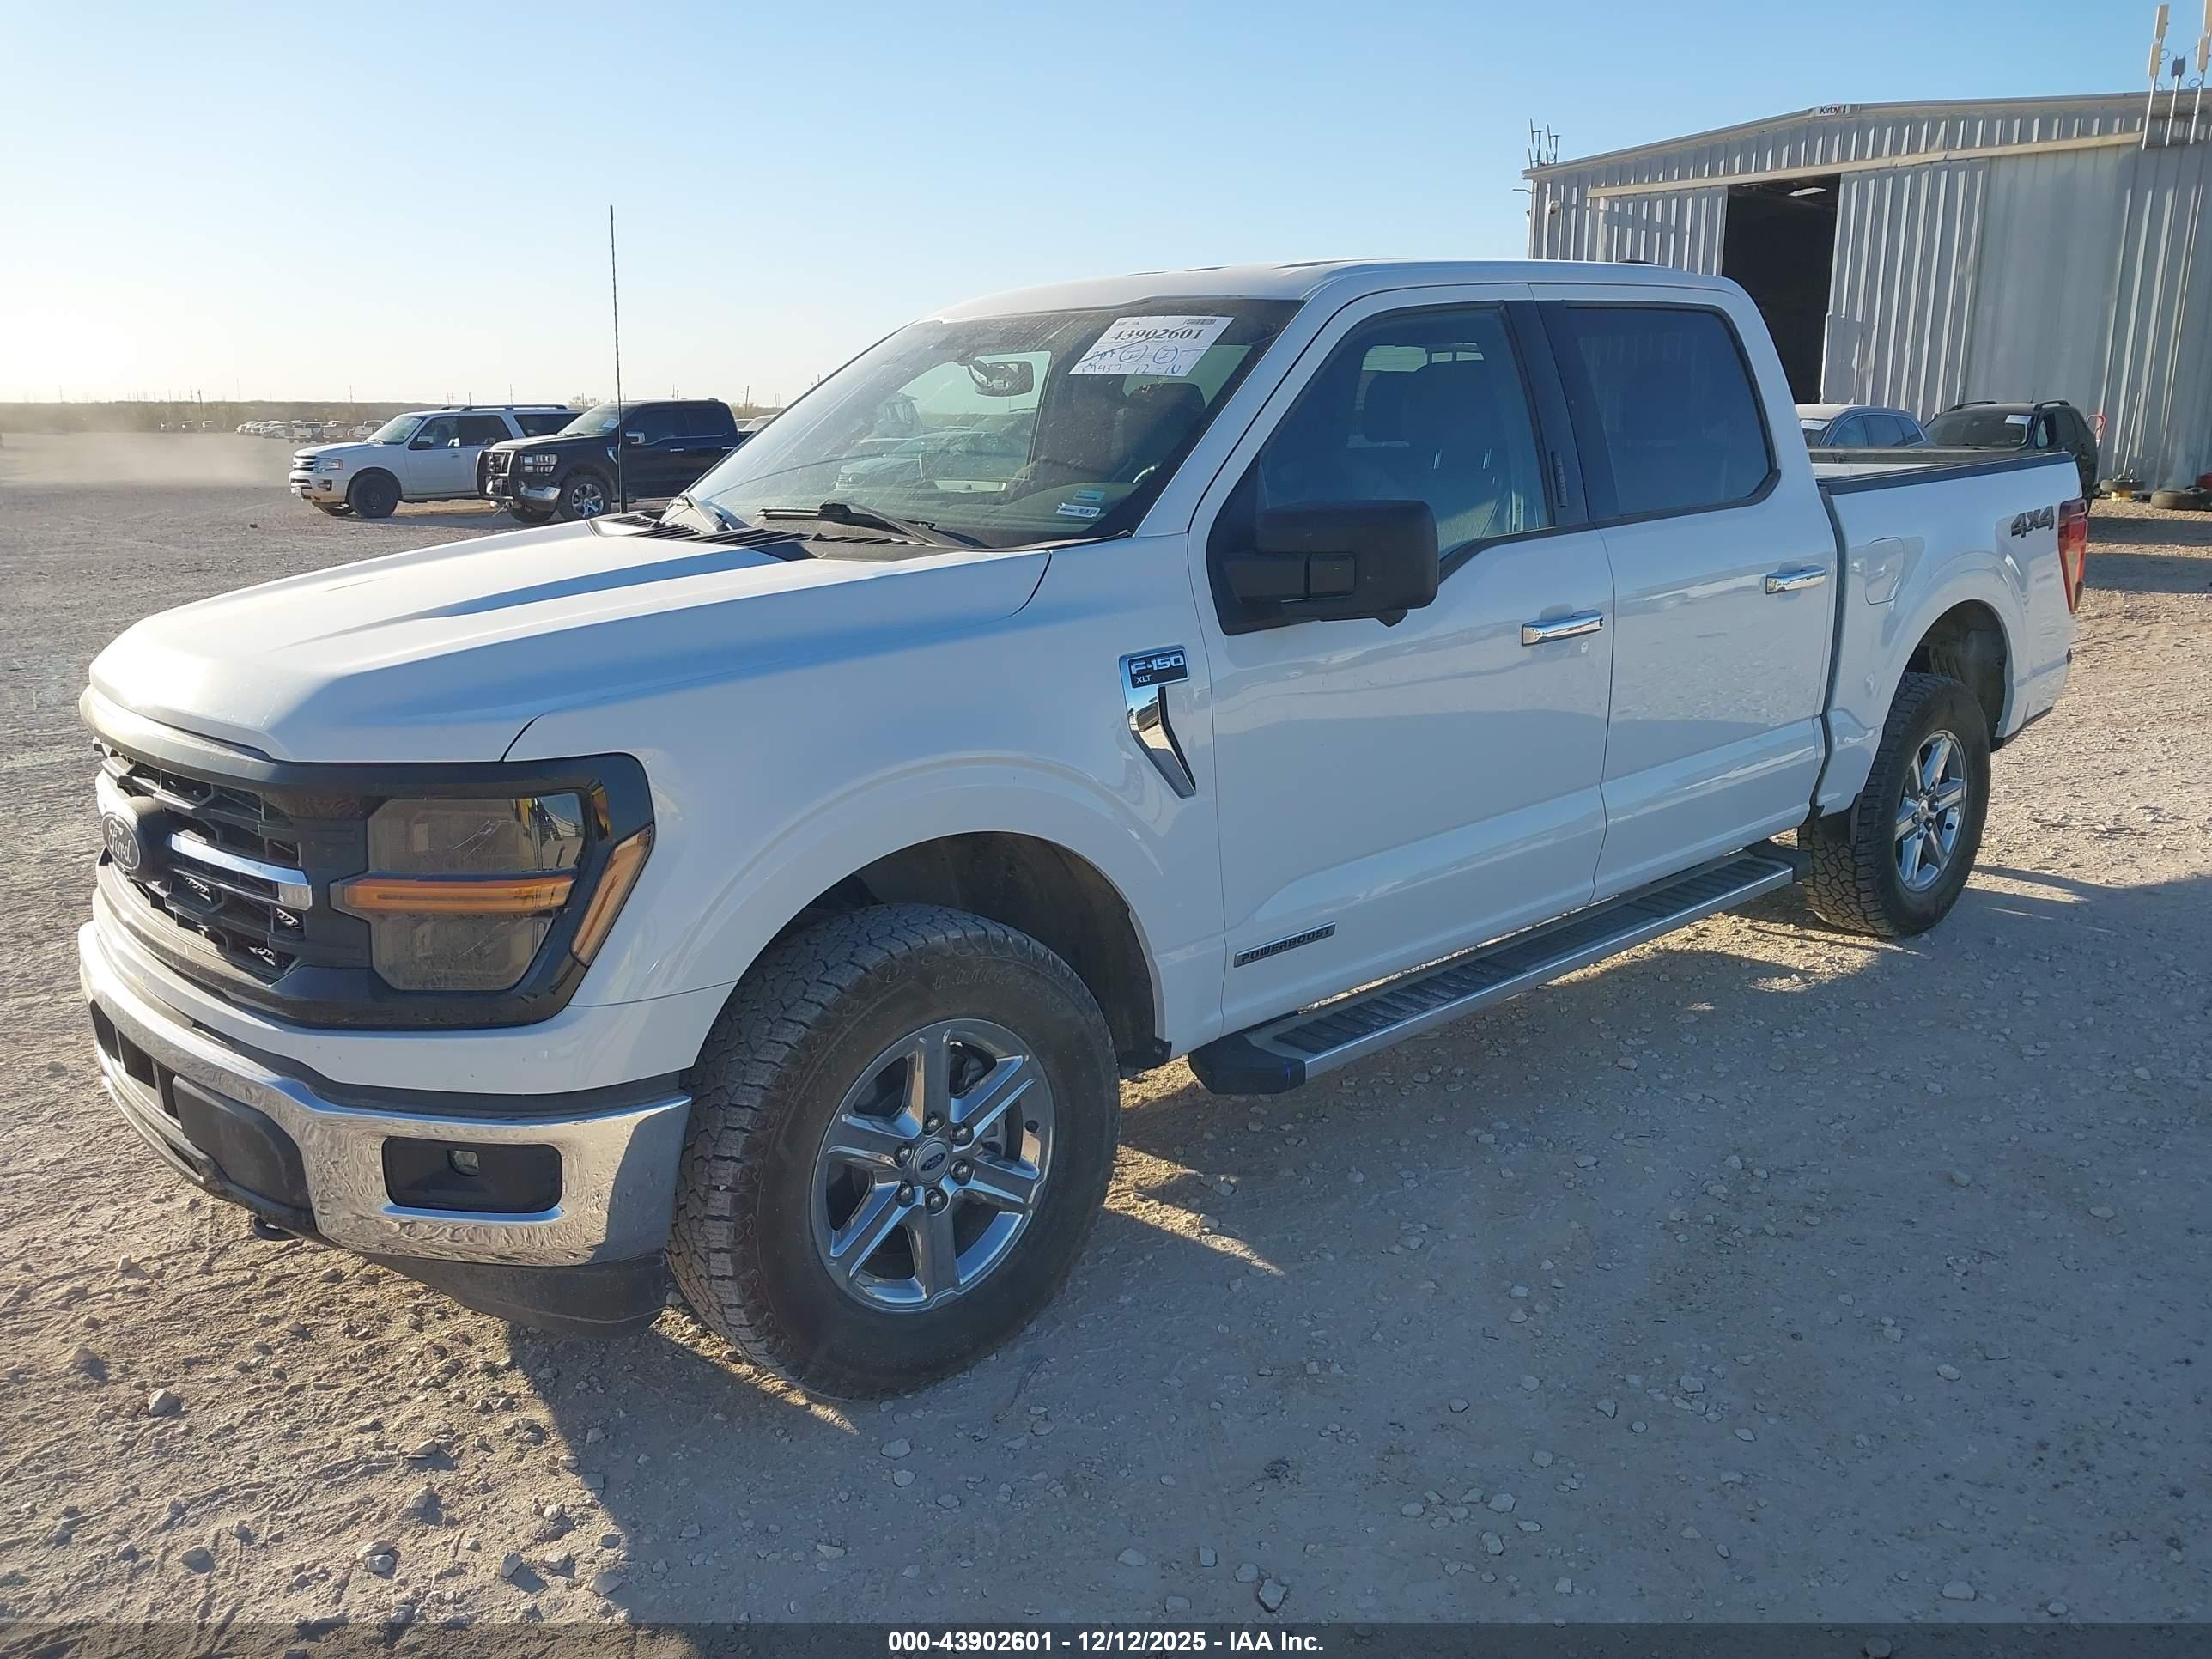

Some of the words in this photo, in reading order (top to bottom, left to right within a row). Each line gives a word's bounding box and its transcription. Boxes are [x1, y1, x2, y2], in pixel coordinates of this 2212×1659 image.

[1820, 106, 1841, 115] Kirby
[1110, 328, 1205, 341] 43902601
[1130, 654, 1185, 675] F-150
[1135, 674, 1152, 684] XLT
[108, 818, 133, 865] Ford
[1240, 925, 1333, 963] POWERBOOST
